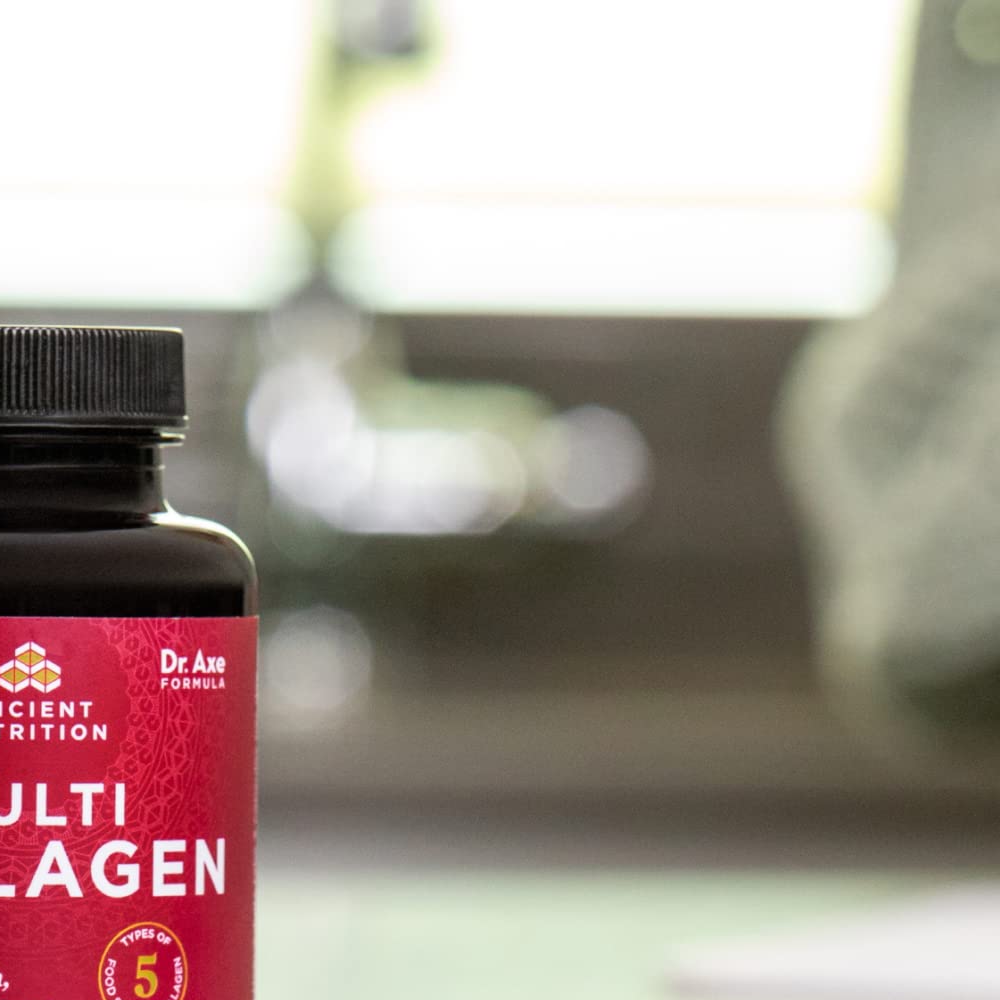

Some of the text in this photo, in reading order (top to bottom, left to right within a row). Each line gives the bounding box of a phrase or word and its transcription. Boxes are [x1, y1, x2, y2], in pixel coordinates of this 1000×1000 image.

[160, 648, 226, 674] Dr. Axe
[160, 677, 226, 690] FORMULA
[119, 928, 172, 947] TYPES OF
[104, 958, 117, 996] FOOD
[134, 952, 158, 998] 5
